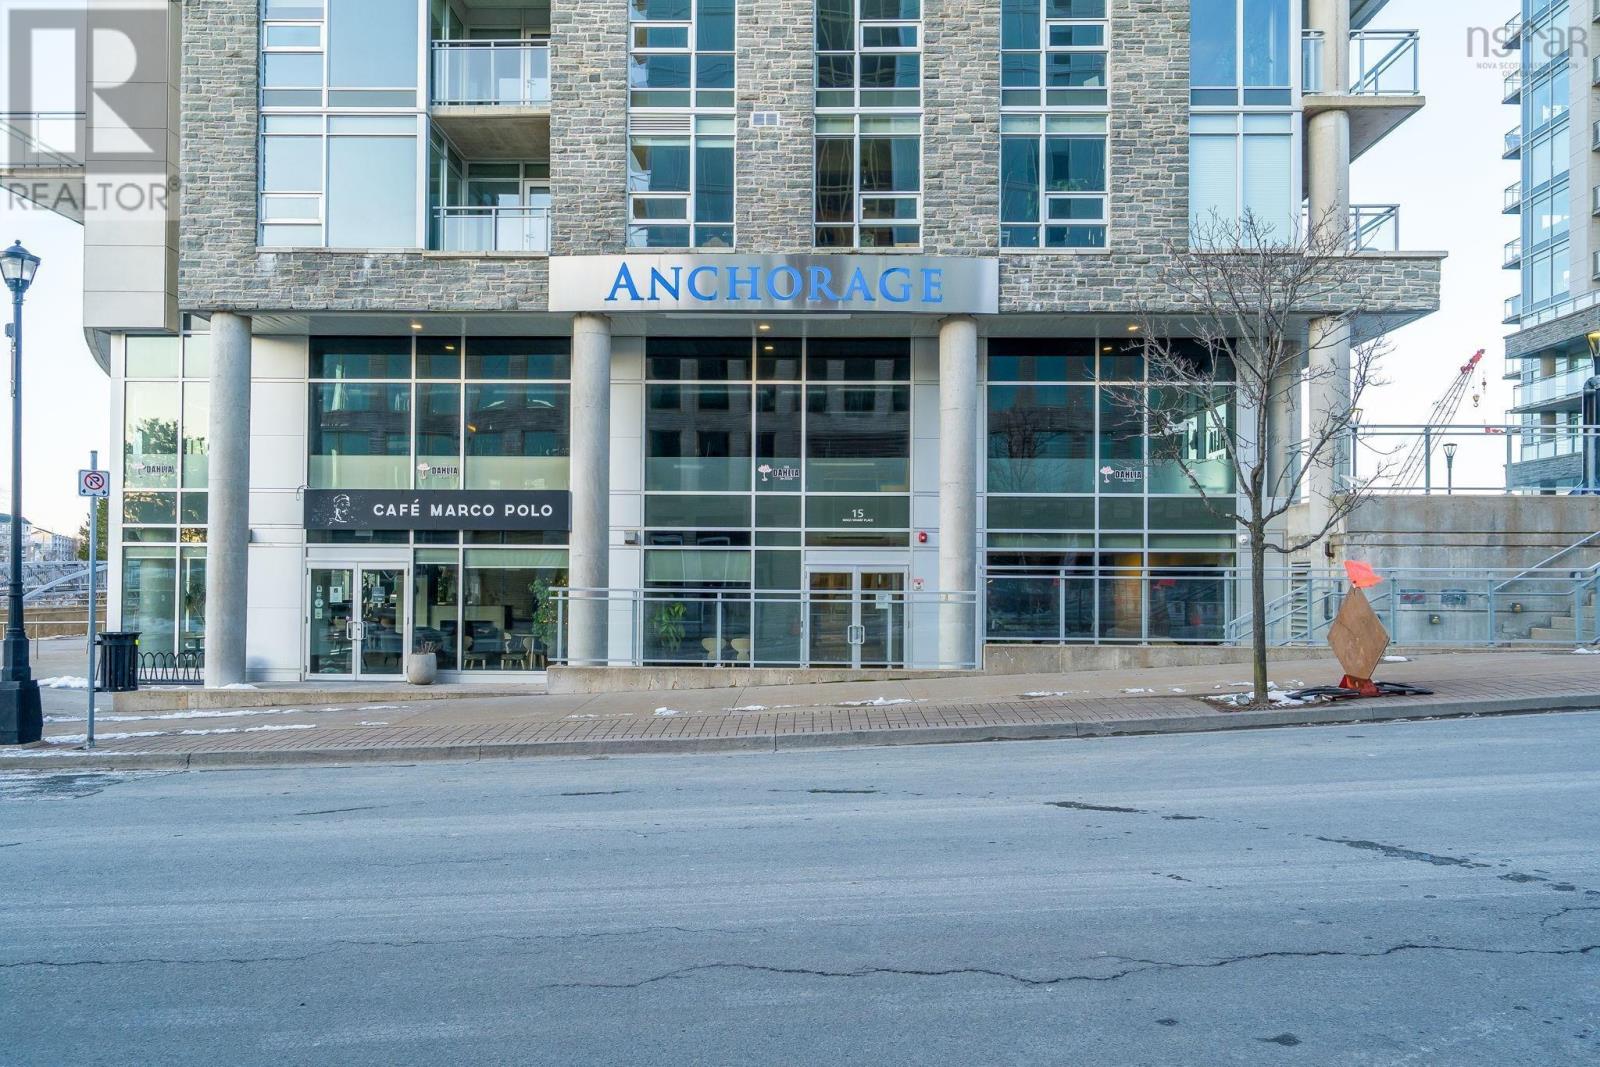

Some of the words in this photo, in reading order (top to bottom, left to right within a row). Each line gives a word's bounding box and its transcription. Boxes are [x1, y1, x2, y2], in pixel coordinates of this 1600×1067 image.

[604, 262, 944, 303] ANCHORAGE
[773, 468, 800, 478] DAHLIA
[1115, 470, 1142, 479] DAHLIA
[373, 498, 420, 517] CAFÉ
[430, 503, 495, 517] MARCO
[504, 503, 553, 517] POLO
[852, 508, 864, 518] 15
